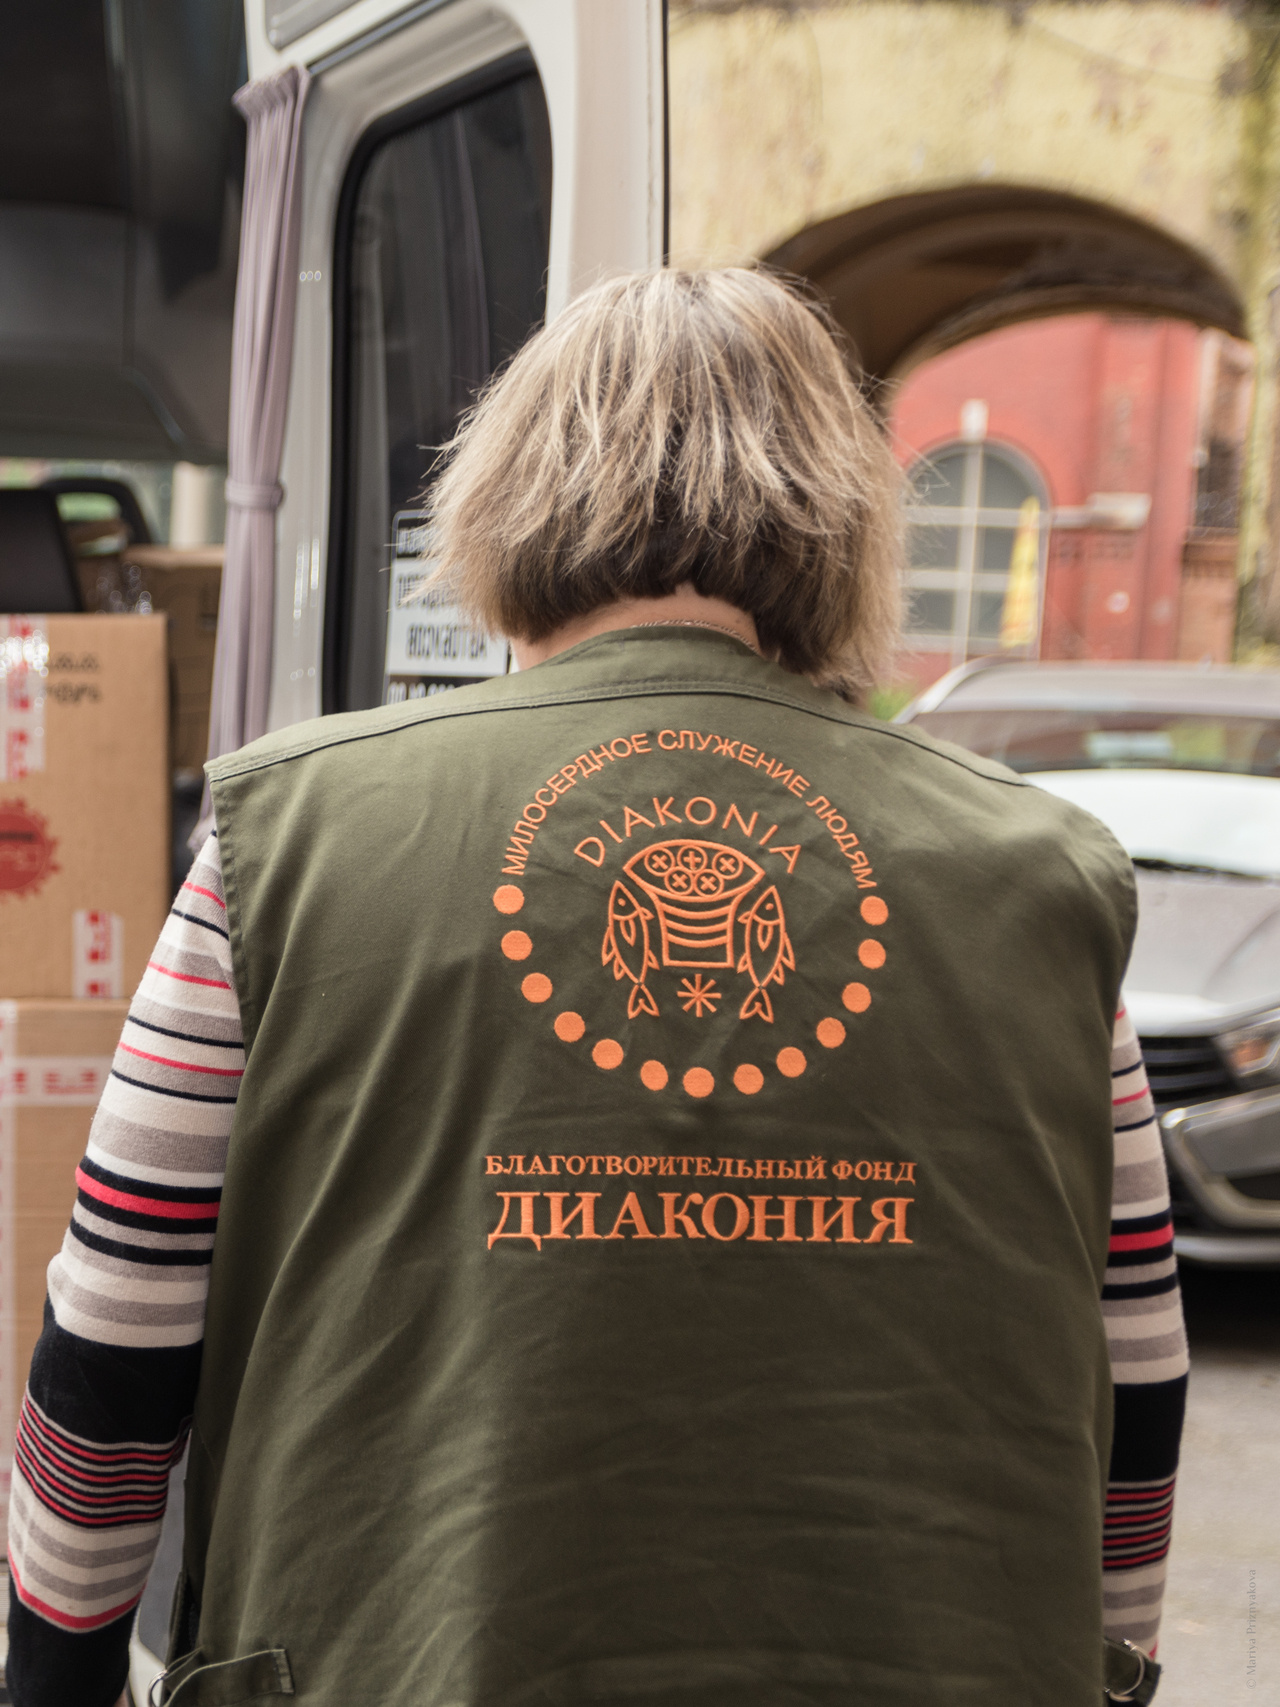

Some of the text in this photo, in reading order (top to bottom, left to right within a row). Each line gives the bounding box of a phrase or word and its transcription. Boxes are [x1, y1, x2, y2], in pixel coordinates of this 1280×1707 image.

[501, 729, 878, 889] МИЛОСЕРДНОЕ СЛУЖЕНИЕ ЛЮДЯМ
[574, 796, 801, 874] DIAKONIA
[485, 1155, 917, 1186] БЛАГОТВОРИТЕЛЬНЫЙ ФОНД
[487, 1191, 915, 1252] ДИАКОНИЯ
